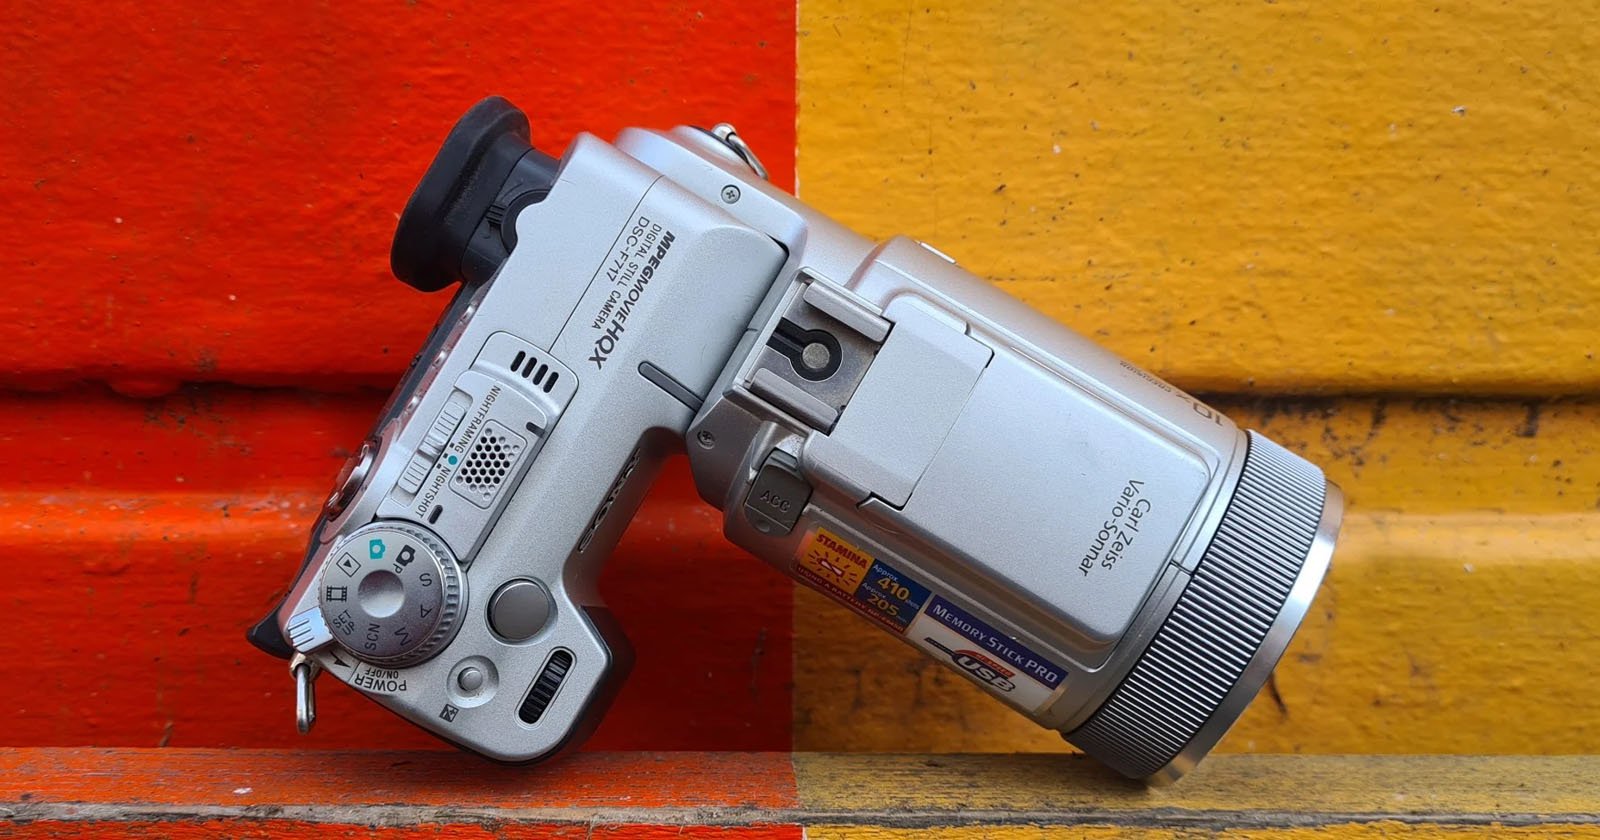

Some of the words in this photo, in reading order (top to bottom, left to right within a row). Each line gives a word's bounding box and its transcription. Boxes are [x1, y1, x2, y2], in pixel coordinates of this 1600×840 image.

[606, 216, 650, 282] DSC-F717
[635, 223, 662, 259] DIGITAL
[616, 261, 639, 287] STILL
[592, 290, 621, 330] CAMERA
[454, 385, 501, 454] NIGHTFRAMING
[415, 466, 451, 519] NIGHTSHOT
[1123, 497, 1151, 533] Carl
[1078, 479, 1144, 577] Vario-Sonnar
[816, 534, 868, 569] STAMINA
[1101, 531, 1134, 571] Zeiss
[393, 563, 403, 575] P
[419, 572, 432, 587] S
[872, 564, 899, 581] Approx
[862, 582, 887, 599] Approx
[877, 578, 911, 601] 410
[420, 604, 433, 619] A
[867, 595, 900, 616] 205
[332, 609, 353, 628] SET
[341, 621, 356, 637] UP
[364, 623, 381, 651] SCN
[394, 626, 413, 646] M
[354, 672, 407, 692] POWER
[363, 668, 399, 679] ON/OFF
[957, 655, 1016, 692] USB
[1025, 659, 1058, 684] PRO
